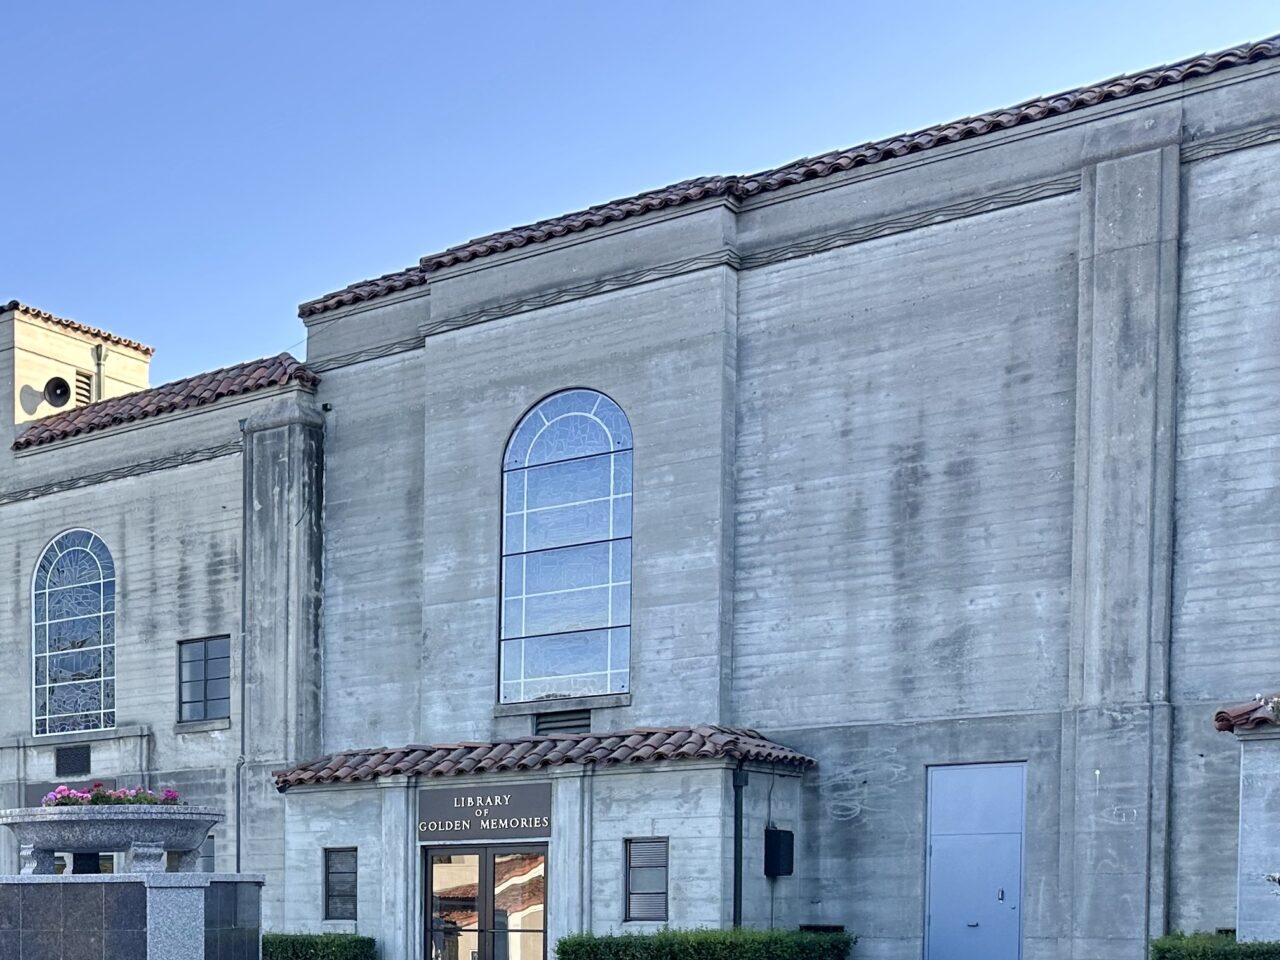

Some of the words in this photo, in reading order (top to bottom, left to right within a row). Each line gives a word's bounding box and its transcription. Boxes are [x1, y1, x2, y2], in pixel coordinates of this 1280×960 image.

[454, 795, 511, 807] LIBRARY
[475, 809, 489, 817] OF
[419, 820, 471, 832] GOLDEN
[480, 817, 549, 829] MEMORIES
